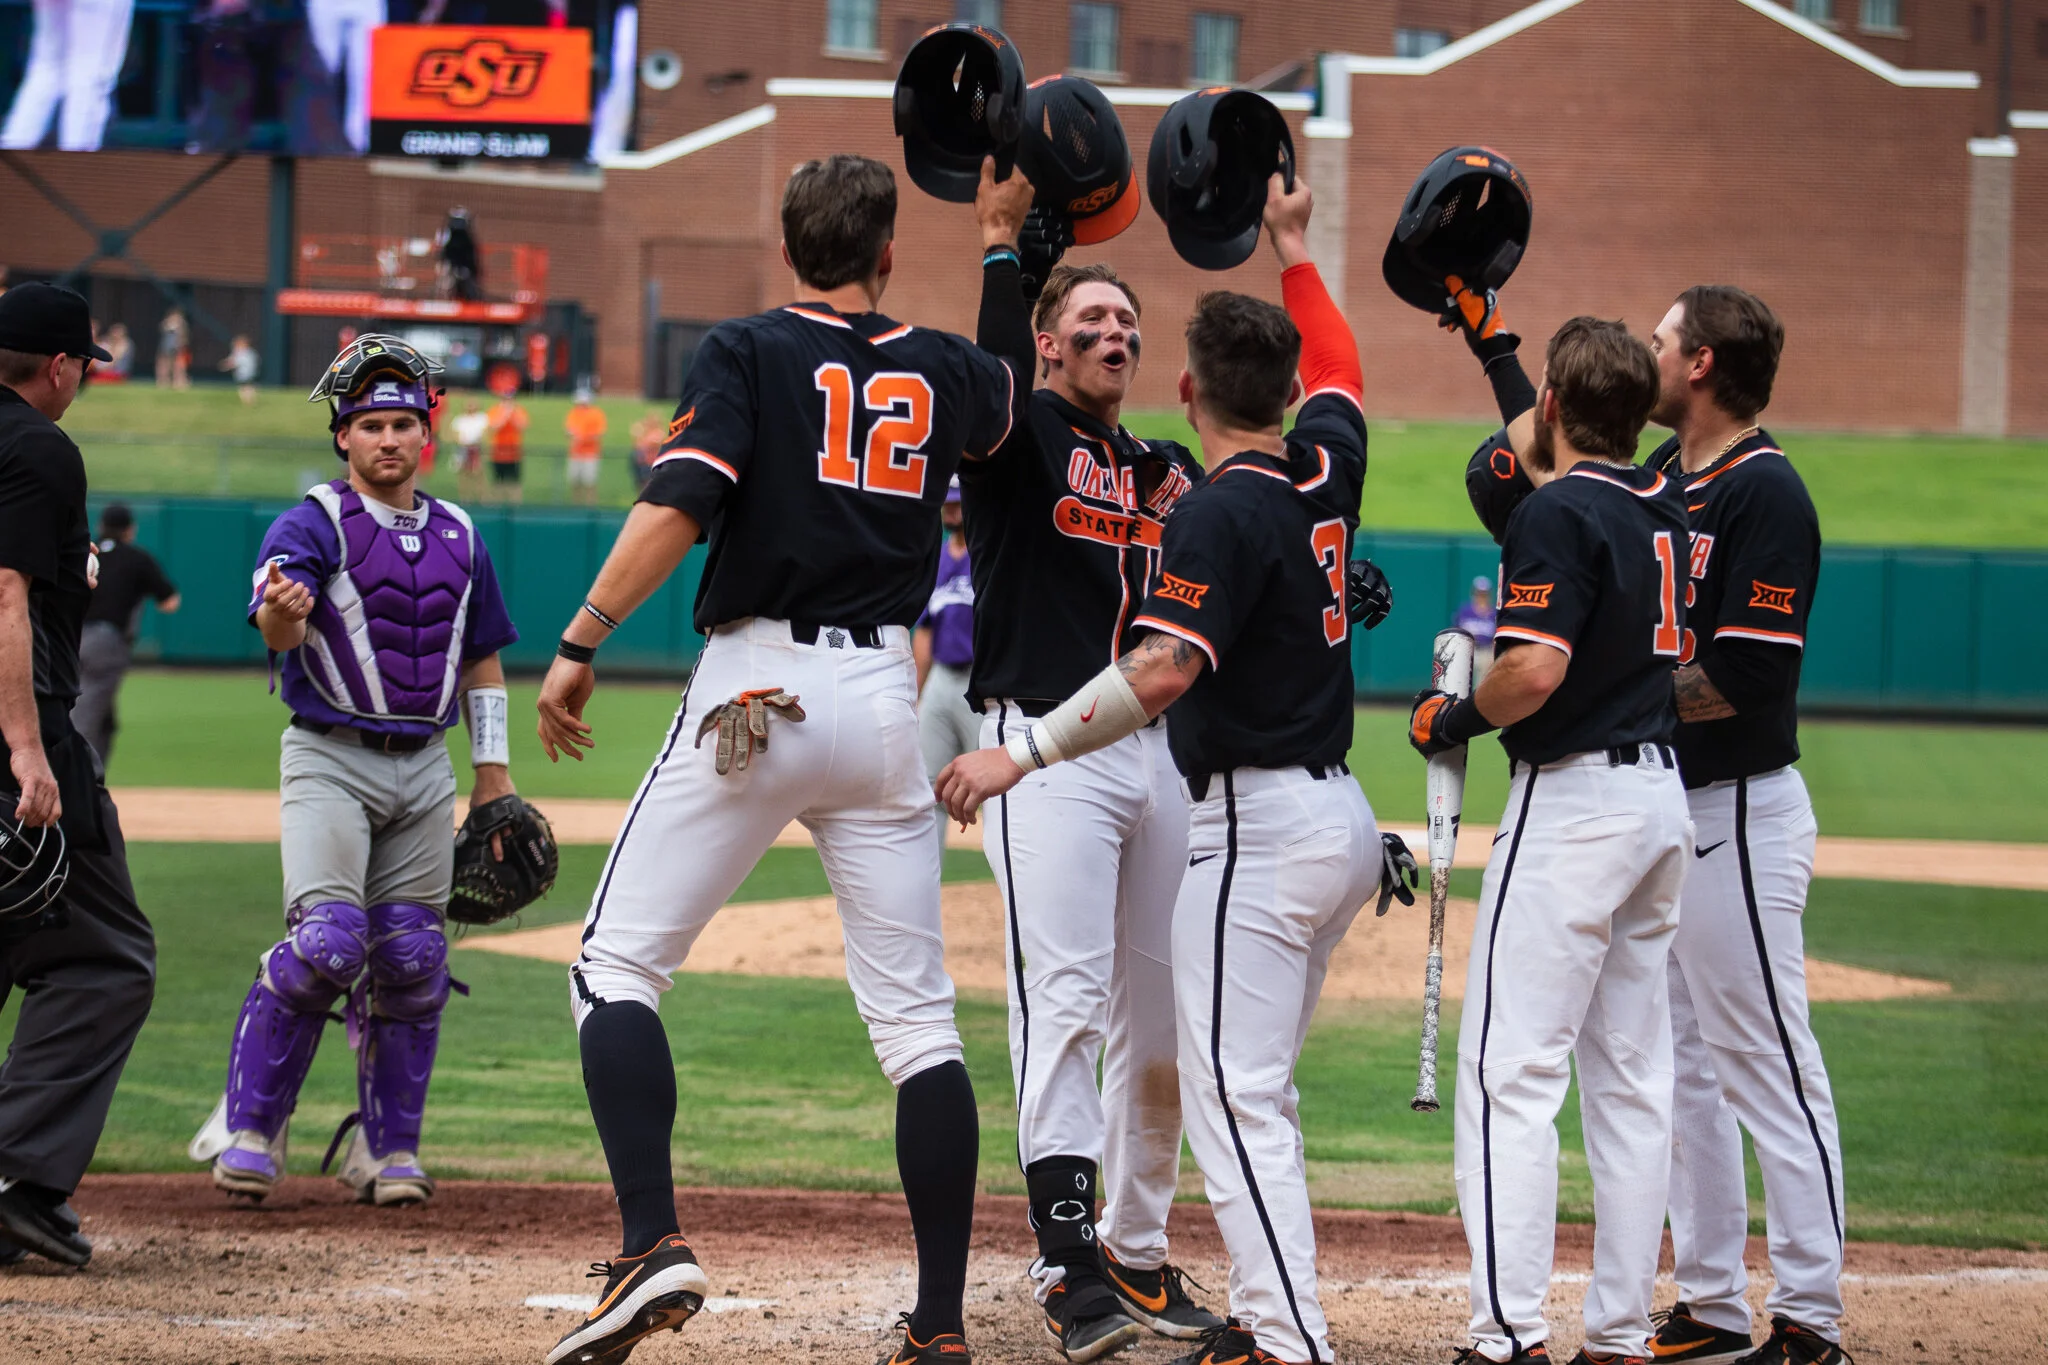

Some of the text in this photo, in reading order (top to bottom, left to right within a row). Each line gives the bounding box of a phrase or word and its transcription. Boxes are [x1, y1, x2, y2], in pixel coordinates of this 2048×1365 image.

[408, 38, 549, 108] OSU
[1067, 181, 1119, 212] OSU
[814, 362, 934, 499] 12
[392, 514, 419, 529] TCU
[1068, 507, 1143, 541] STATE
[1310, 517, 1348, 648] 3
[1652, 531, 1681, 656] 1
